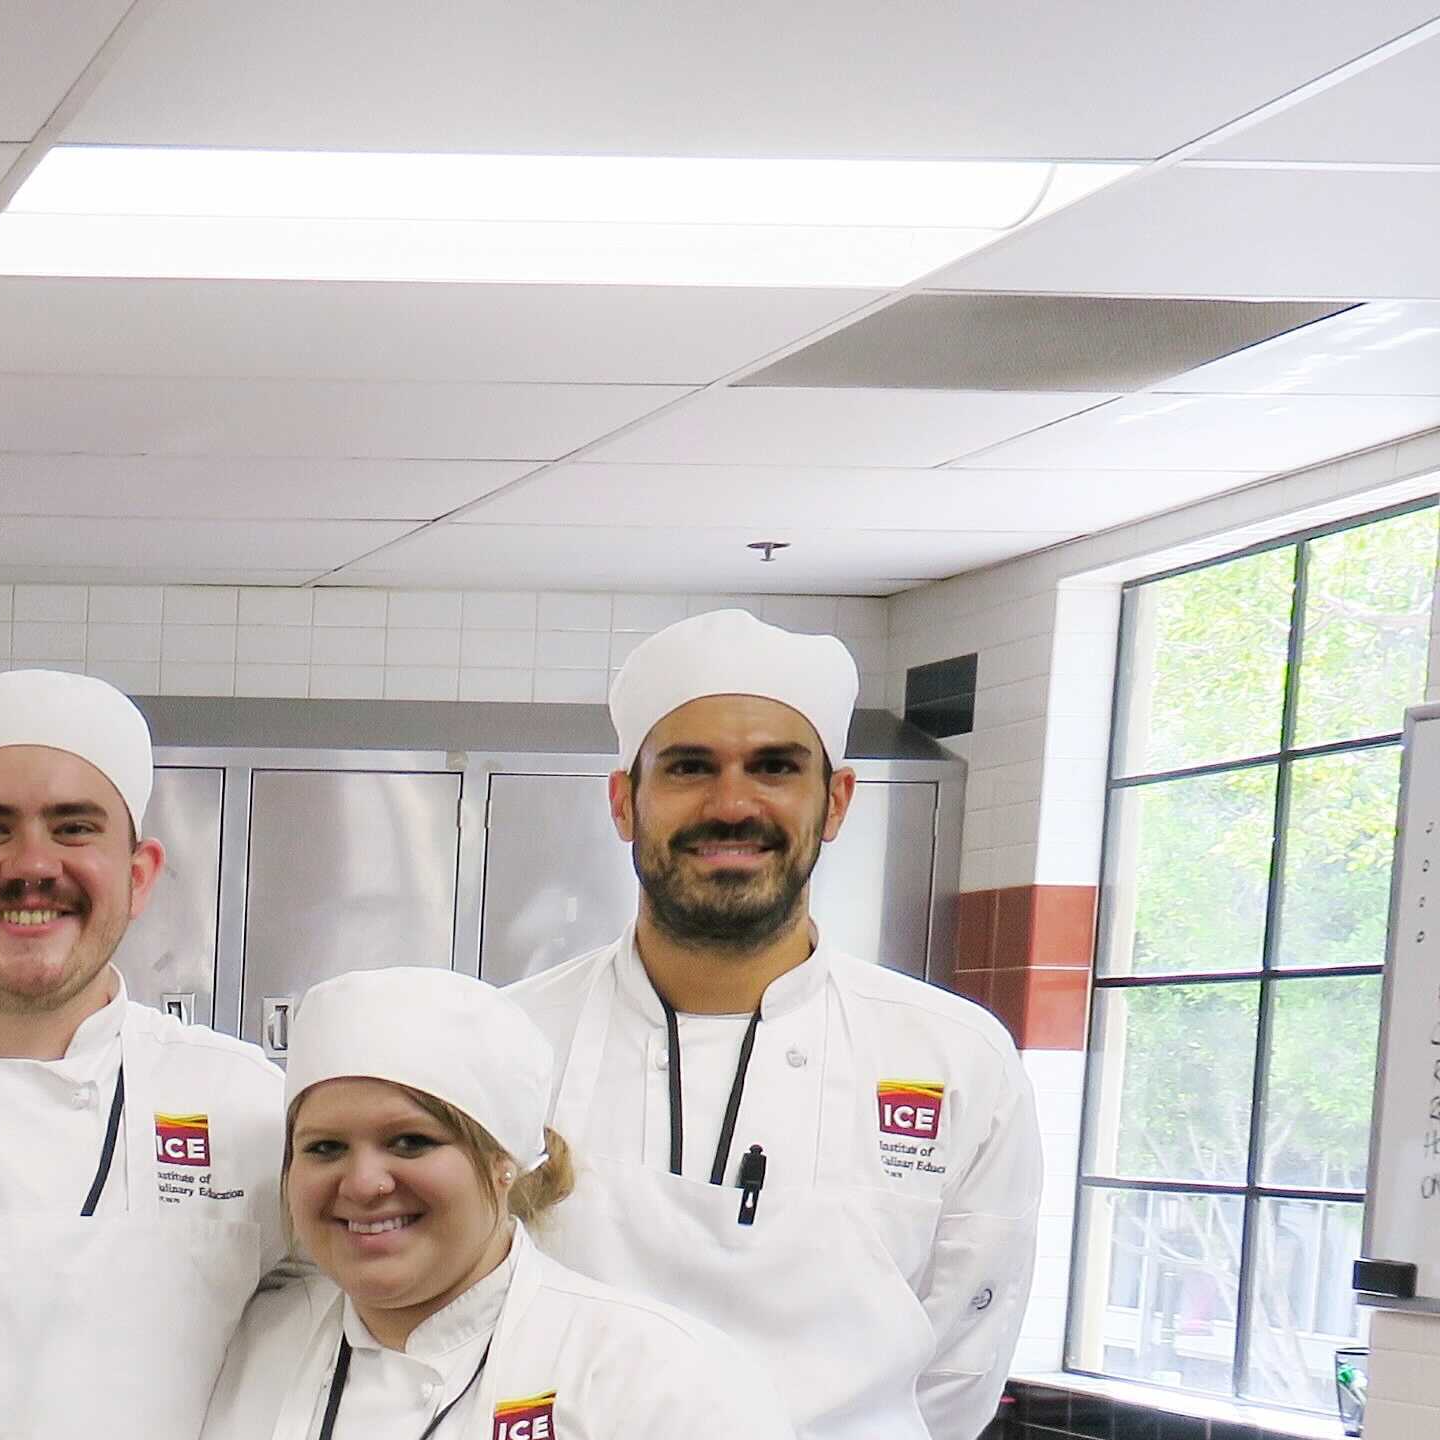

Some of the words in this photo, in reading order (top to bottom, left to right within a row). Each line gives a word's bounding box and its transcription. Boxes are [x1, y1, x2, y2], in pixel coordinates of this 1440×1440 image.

[884, 1104, 935, 1131] ICE
[156, 1136, 205, 1159] ICE
[920, 1147, 935, 1156] of
[199, 1174, 211, 1184] of
[159, 1184, 194, 1197] ulinary
